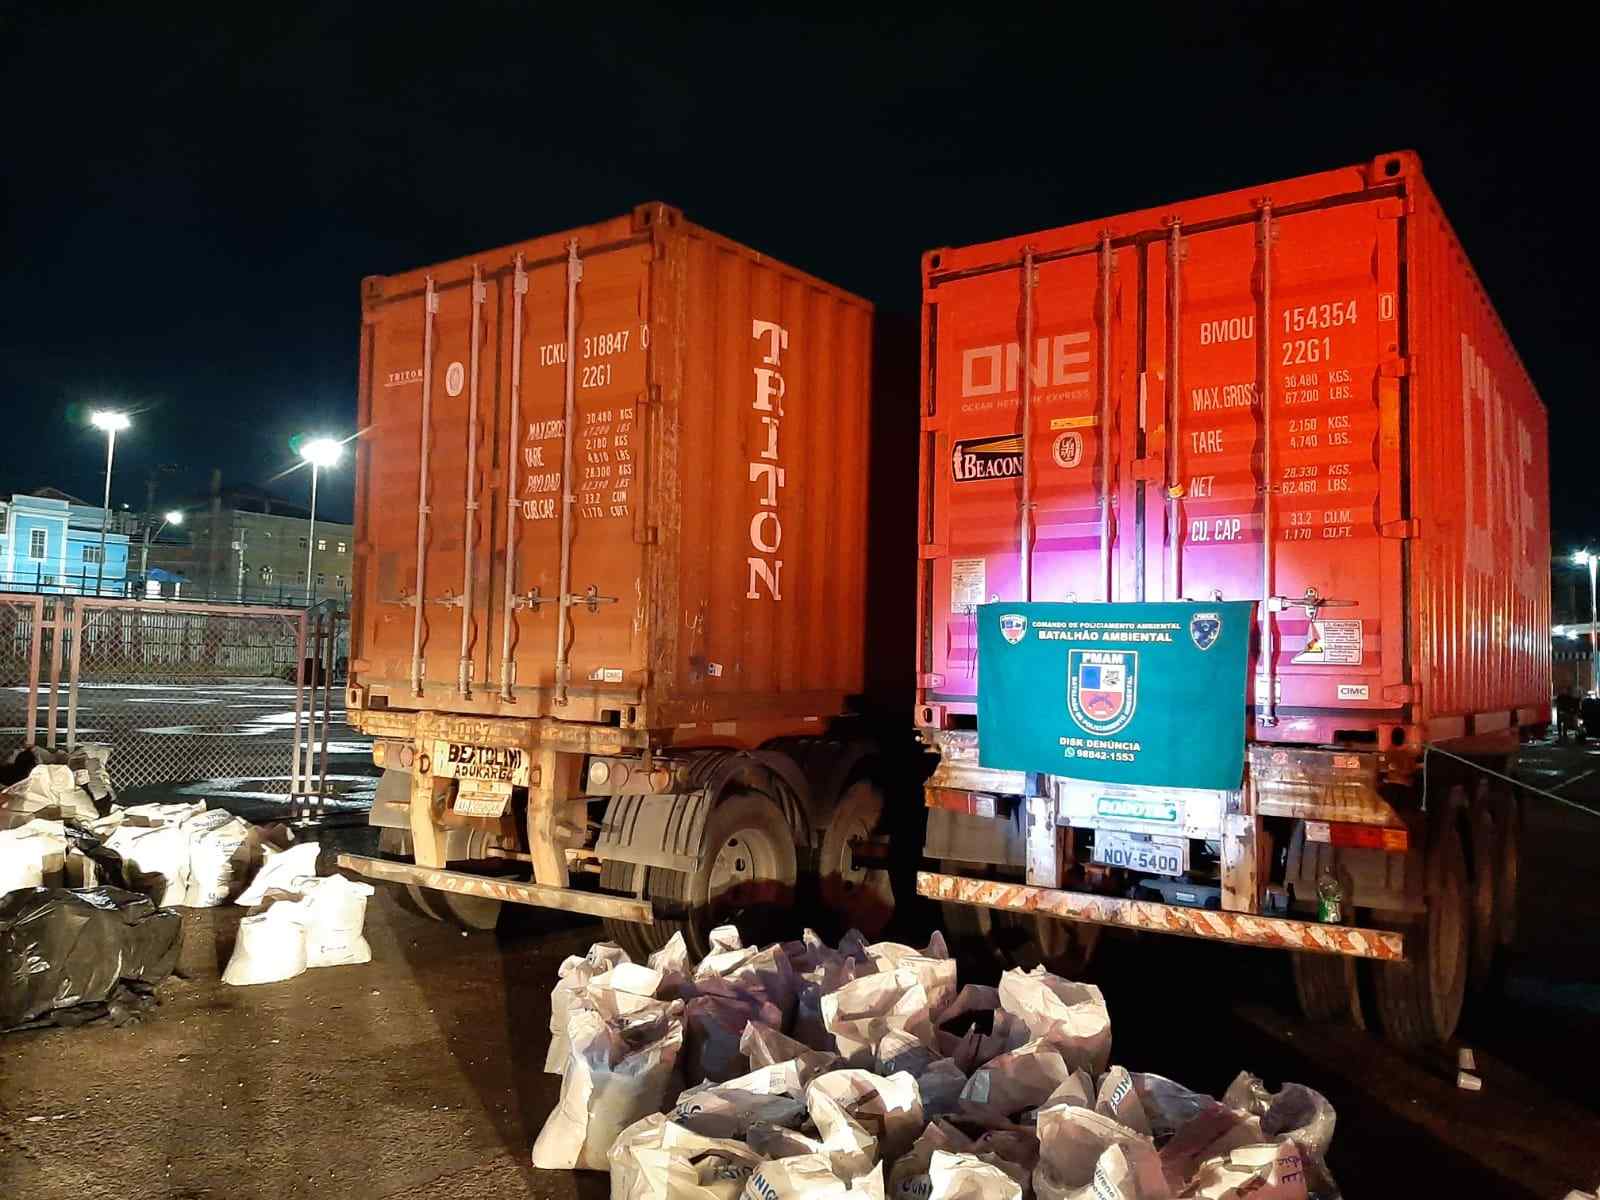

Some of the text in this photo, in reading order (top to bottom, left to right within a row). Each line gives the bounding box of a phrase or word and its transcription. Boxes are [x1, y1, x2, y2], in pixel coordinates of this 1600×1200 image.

[1200, 316, 1255, 344] BMOU
[1282, 301, 1358, 333] 154354
[583, 330, 630, 359] 318847
[1282, 337, 1331, 366] 22G1
[582, 363, 612, 388] 22G1
[962, 332, 1090, 397] ONE
[1191, 429, 1223, 454] TARE
[752, 319, 788, 600] TRITON
[964, 453, 1023, 479] BEACON
[1190, 476, 1215, 497] NET
[1214, 518, 1242, 541] CAP.
[1038, 630, 1173, 643] BATALHÃO AMBIENTAL
[1082, 652, 1125, 664] PMAM
[1340, 687, 1366, 695] CIMC
[1059, 736, 1084, 746] DISK
[1104, 848, 1178, 872] NOV-5400
